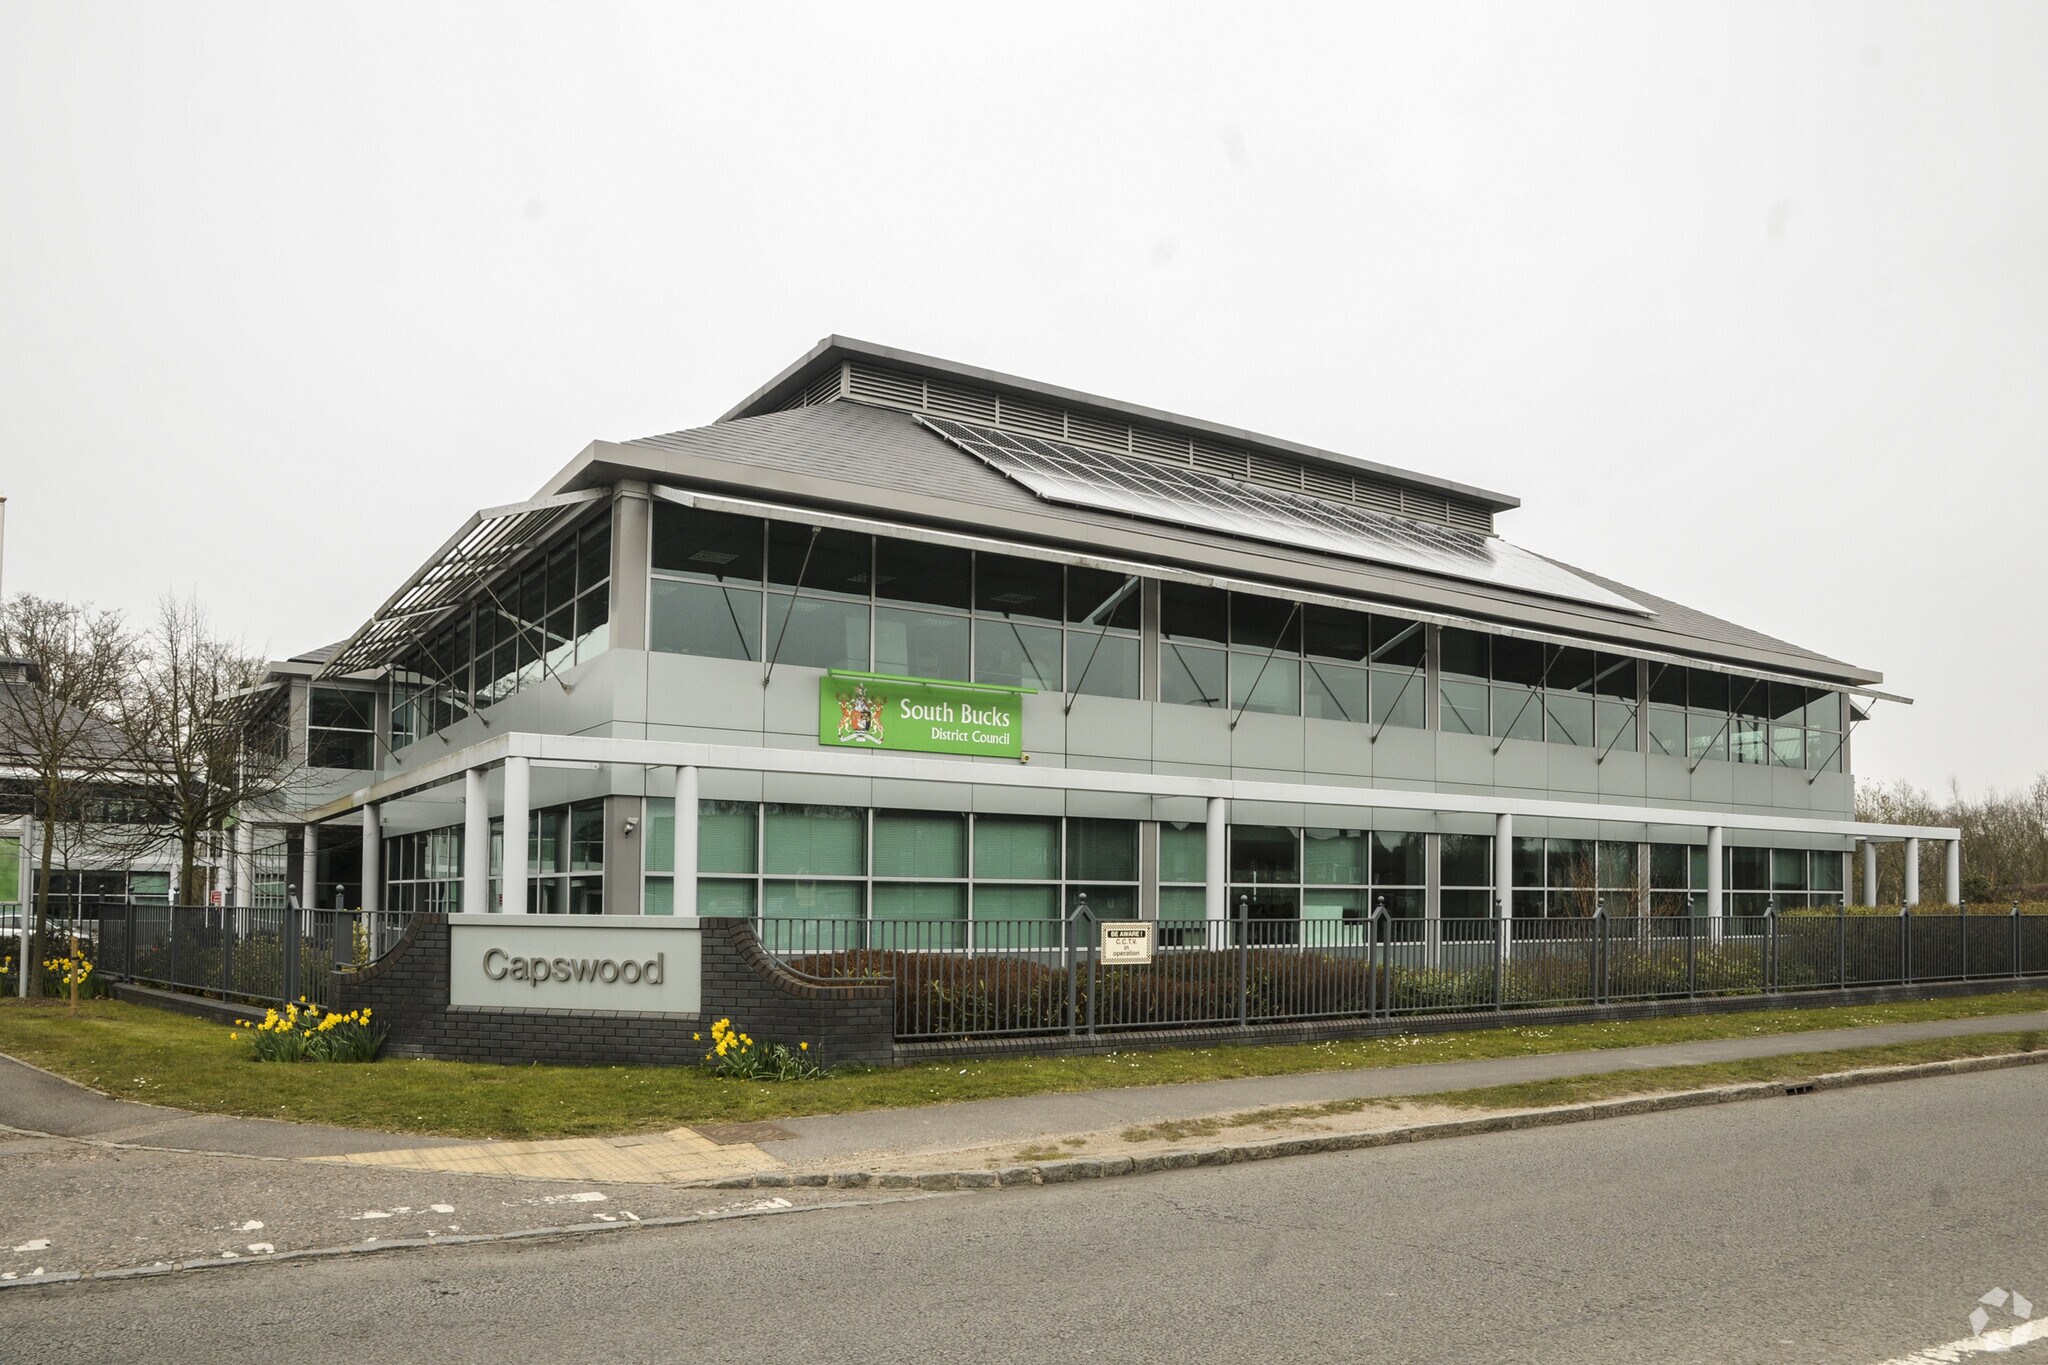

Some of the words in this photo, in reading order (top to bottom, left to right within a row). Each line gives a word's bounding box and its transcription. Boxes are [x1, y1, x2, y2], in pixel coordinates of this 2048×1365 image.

[900, 698, 954, 723] South
[961, 703, 1010, 727] Bucks
[931, 726, 968, 742] District
[971, 730, 1010, 745] Council
[482, 947, 664, 987] Capswood
